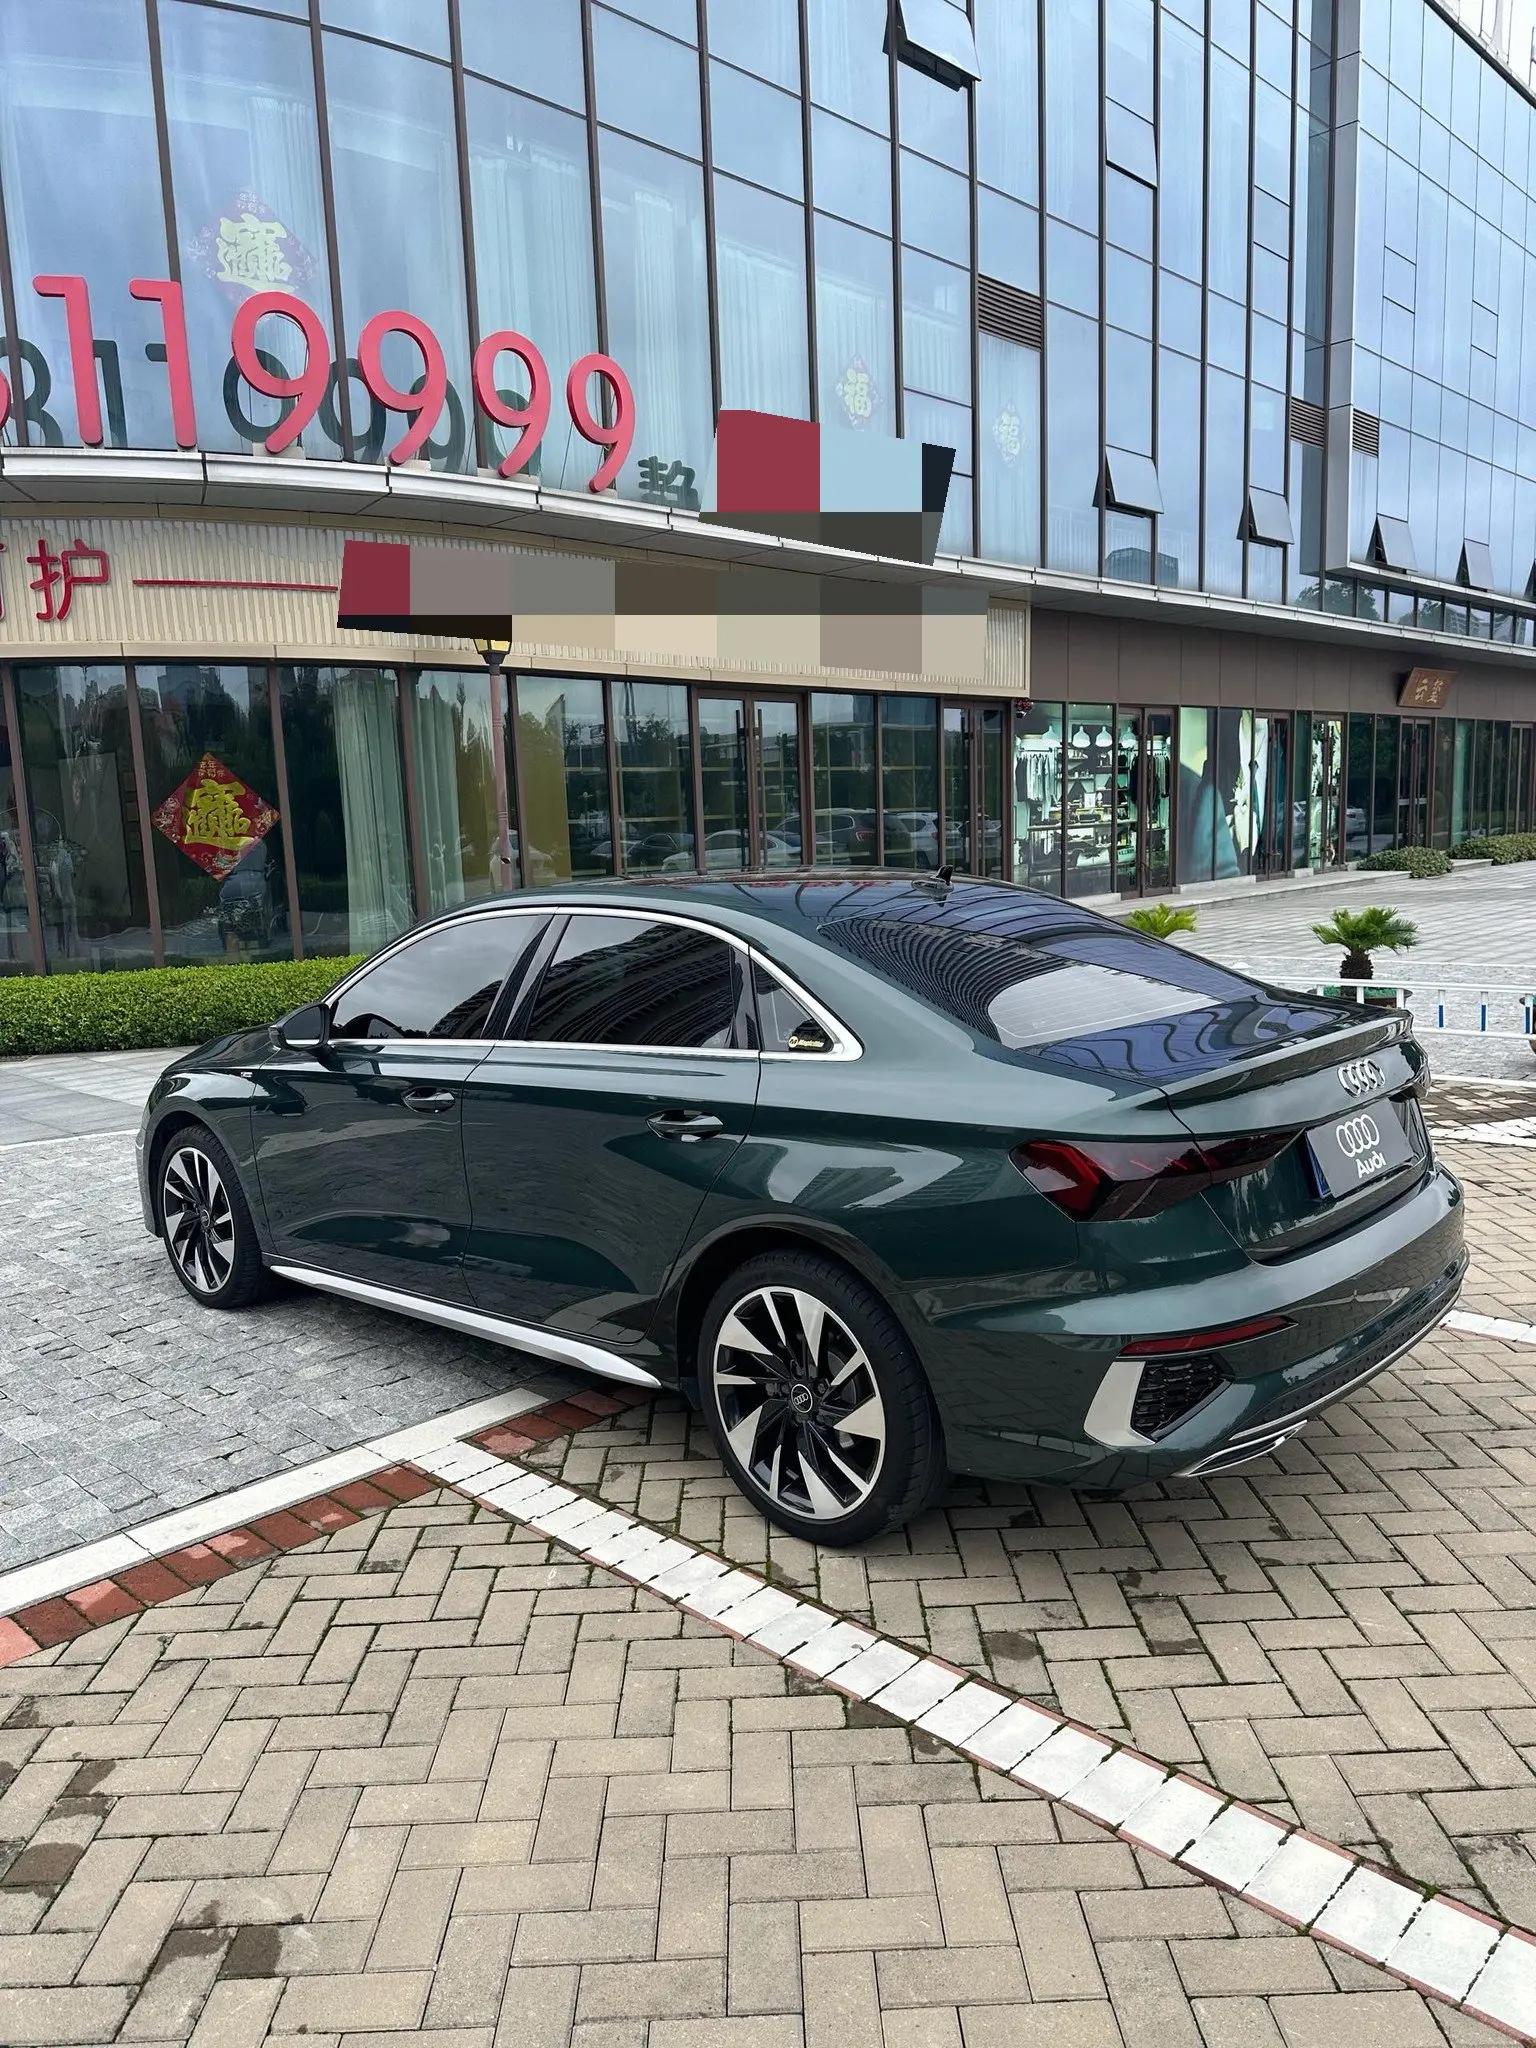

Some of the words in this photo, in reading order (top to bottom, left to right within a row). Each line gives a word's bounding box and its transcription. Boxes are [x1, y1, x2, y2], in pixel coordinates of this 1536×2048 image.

[0, 273, 636, 493] 119999
[0, 537, 111, 622] 护
[1355, 1150, 1387, 1179] Audi
